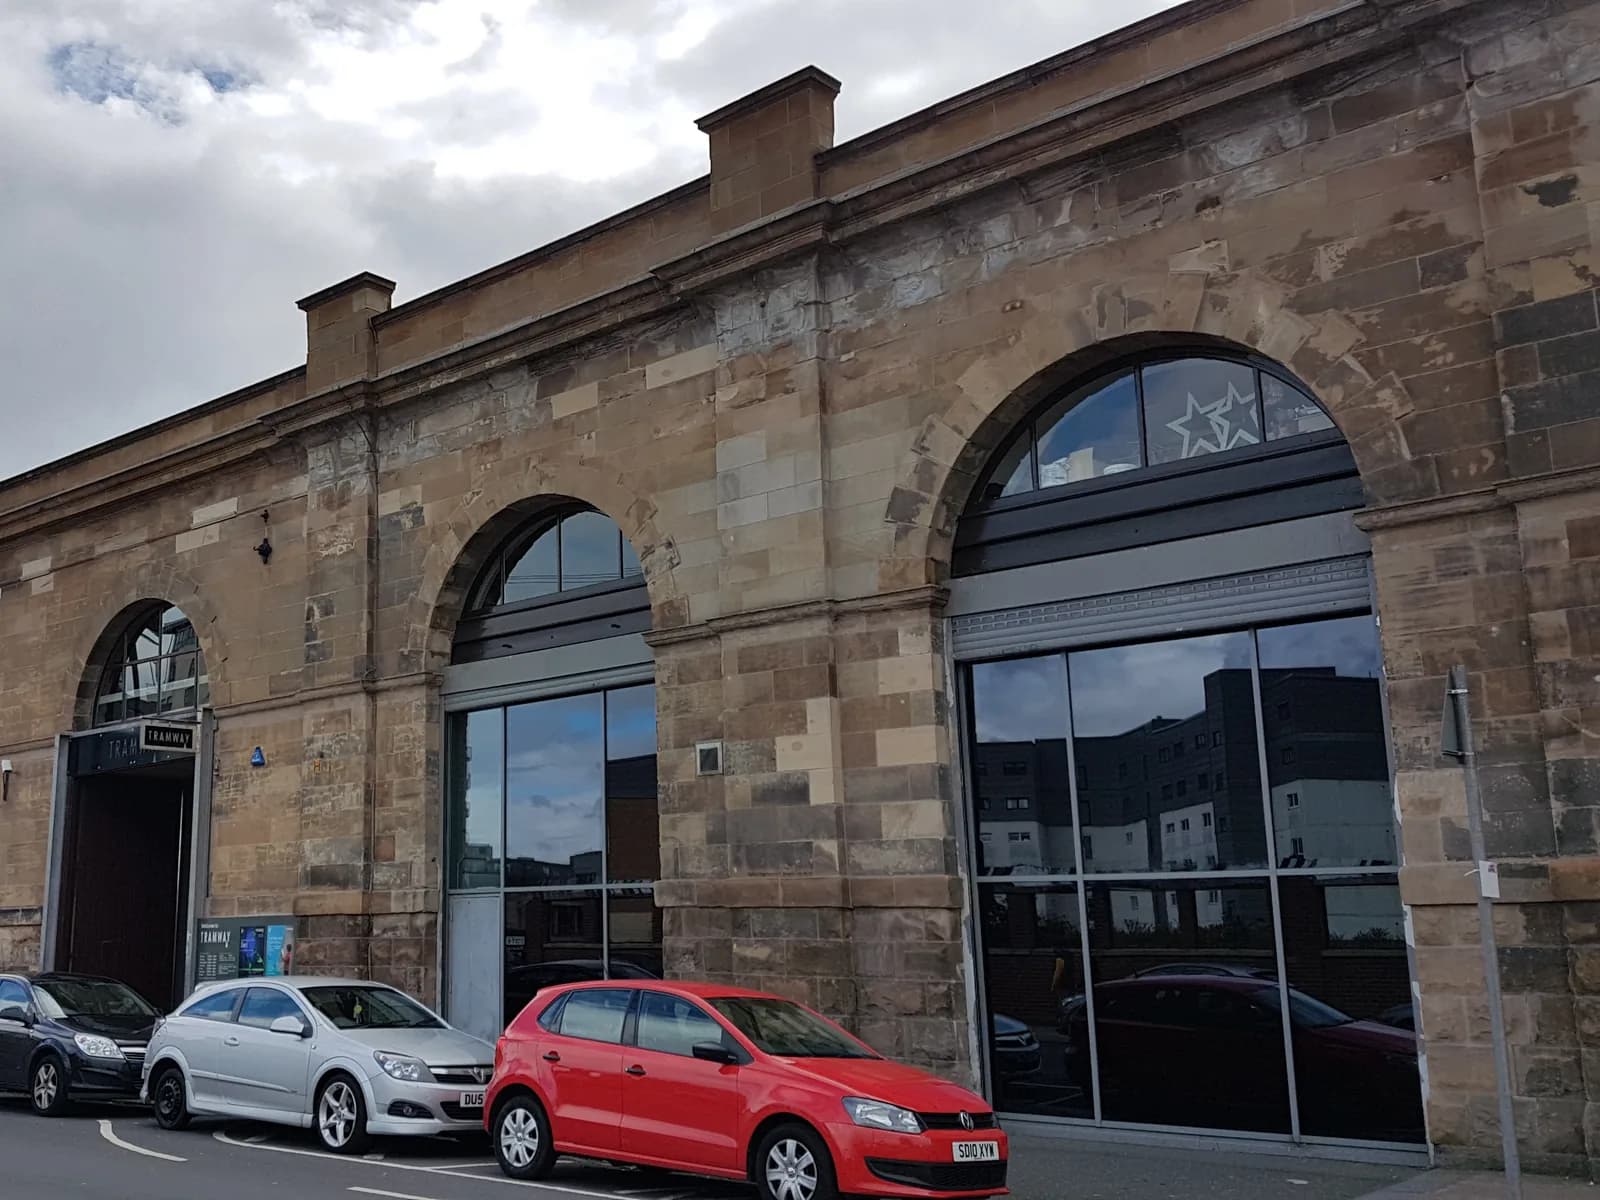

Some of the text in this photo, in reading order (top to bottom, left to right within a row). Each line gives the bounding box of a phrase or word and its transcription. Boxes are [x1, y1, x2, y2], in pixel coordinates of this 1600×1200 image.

[148, 730, 190, 749] TRAMWAY
[109, 737, 144, 761] TRAM
[200, 931, 231, 948] TRAMWAY
[464, 1094, 483, 1105] DU5
